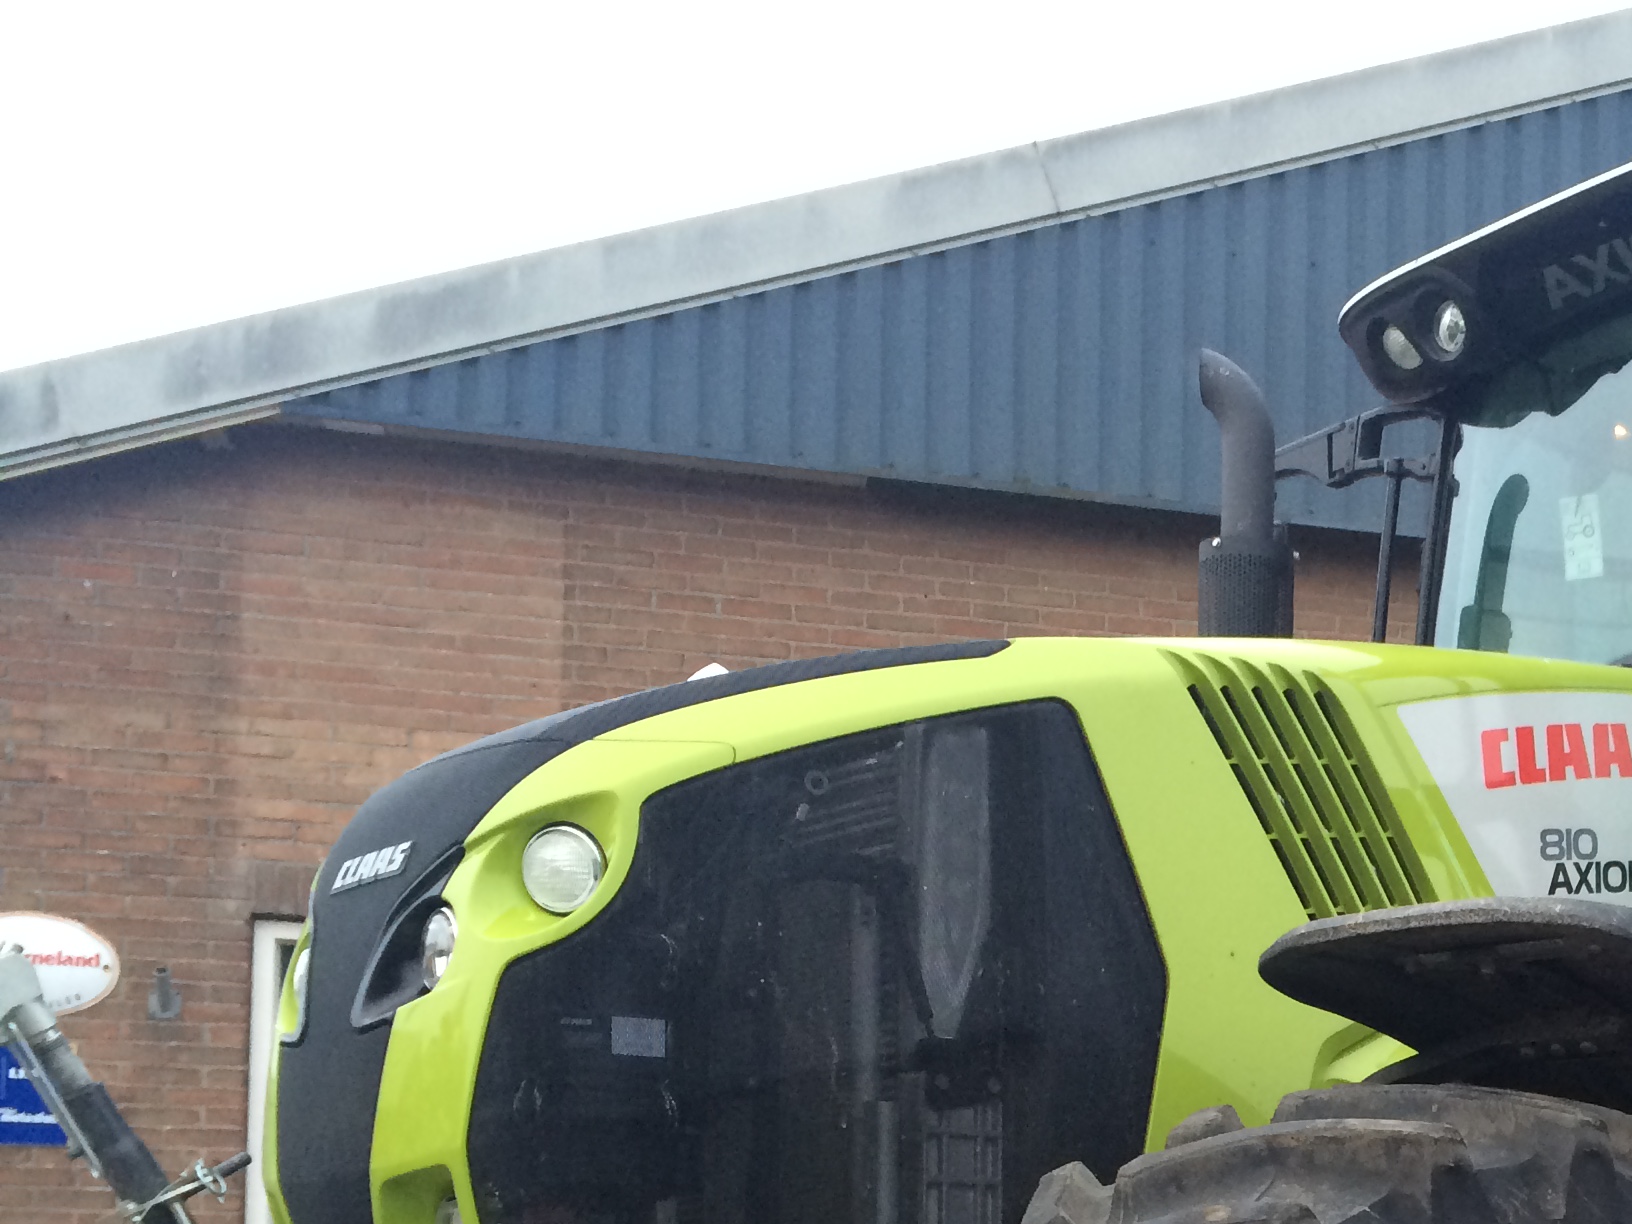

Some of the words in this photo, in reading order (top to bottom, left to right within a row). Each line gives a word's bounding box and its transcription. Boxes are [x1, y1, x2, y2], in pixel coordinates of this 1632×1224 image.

[1540, 828, 1598, 861] 810
[330, 840, 413, 894] CLAAS
[24, 951, 101, 967] neland
